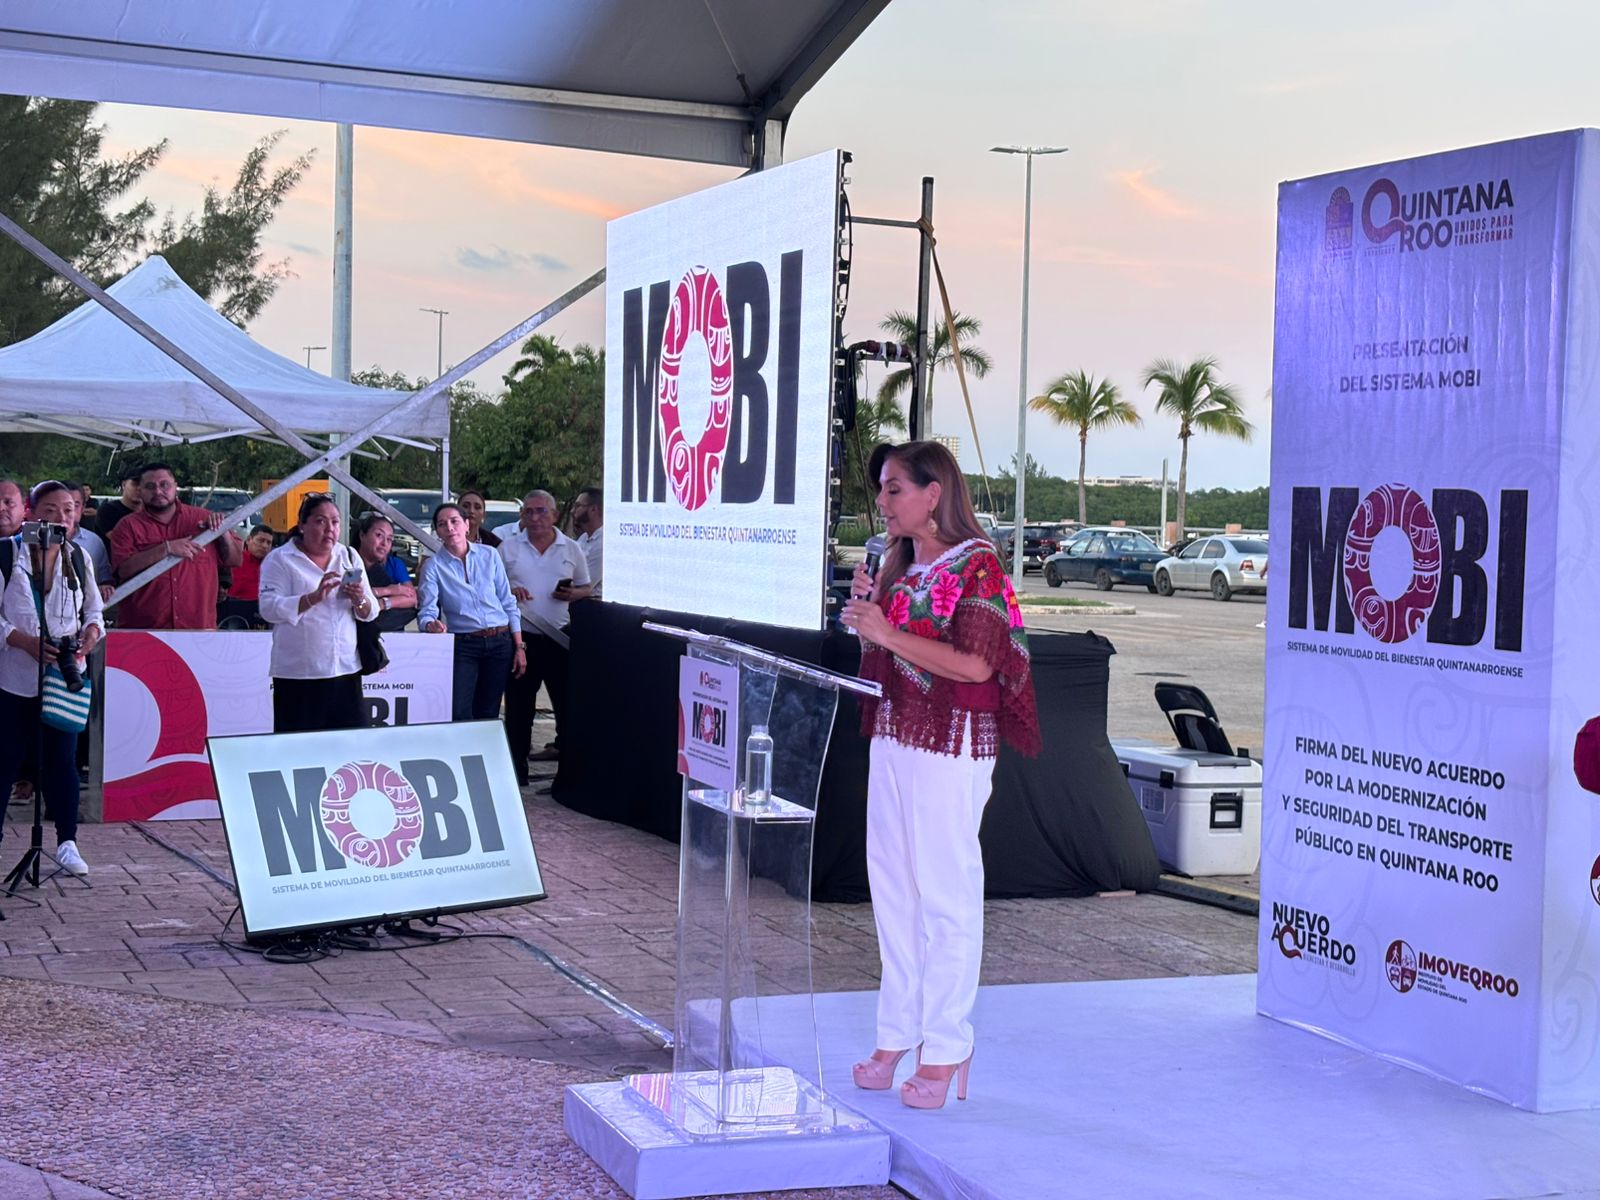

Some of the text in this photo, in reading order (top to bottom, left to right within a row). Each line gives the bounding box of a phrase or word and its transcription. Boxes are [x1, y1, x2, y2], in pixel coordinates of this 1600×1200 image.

[1362, 178, 1514, 243] QUINTANA
[1454, 214, 1513, 234] UNIDOS PARA
[1400, 219, 1453, 253] ROO
[1454, 228, 1513, 247] TRANSFORMAR
[1353, 332, 1469, 360] PRESENTACIÓN
[620, 248, 803, 511] MOBI
[1340, 369, 1481, 393] DEL SISTEMA MOBI
[619, 523, 797, 545] SISTEMA DE MOVILIDAD DEL BIENESTAR QUINTANARROENSE
[1288, 482, 1528, 652] MOBI
[1287, 641, 1524, 678] SISTEMA DE MOVILIDAD DEL BIENESTAR QUINTANARROENSE
[692, 701, 727, 748] MOBI
[1295, 736, 1506, 790] FIRMA DEL NUEVO ACUERDO
[248, 754, 505, 877] MOBI
[1305, 768, 1487, 821] POR LA MODERNIZACIÓN
[1282, 794, 1513, 861] Y SEGURIDAD DEL TRANSPORTE
[272, 859, 511, 894] SISTEMA DE MOVILIDAD DEL BIENESTAR QUINTANARROENSE
[1295, 825, 1499, 892] PÚBLICO EN QUINTANA ROO
[1272, 901, 1330, 936] NUEVO
[1418, 951, 1519, 998] IMOVEQROO
